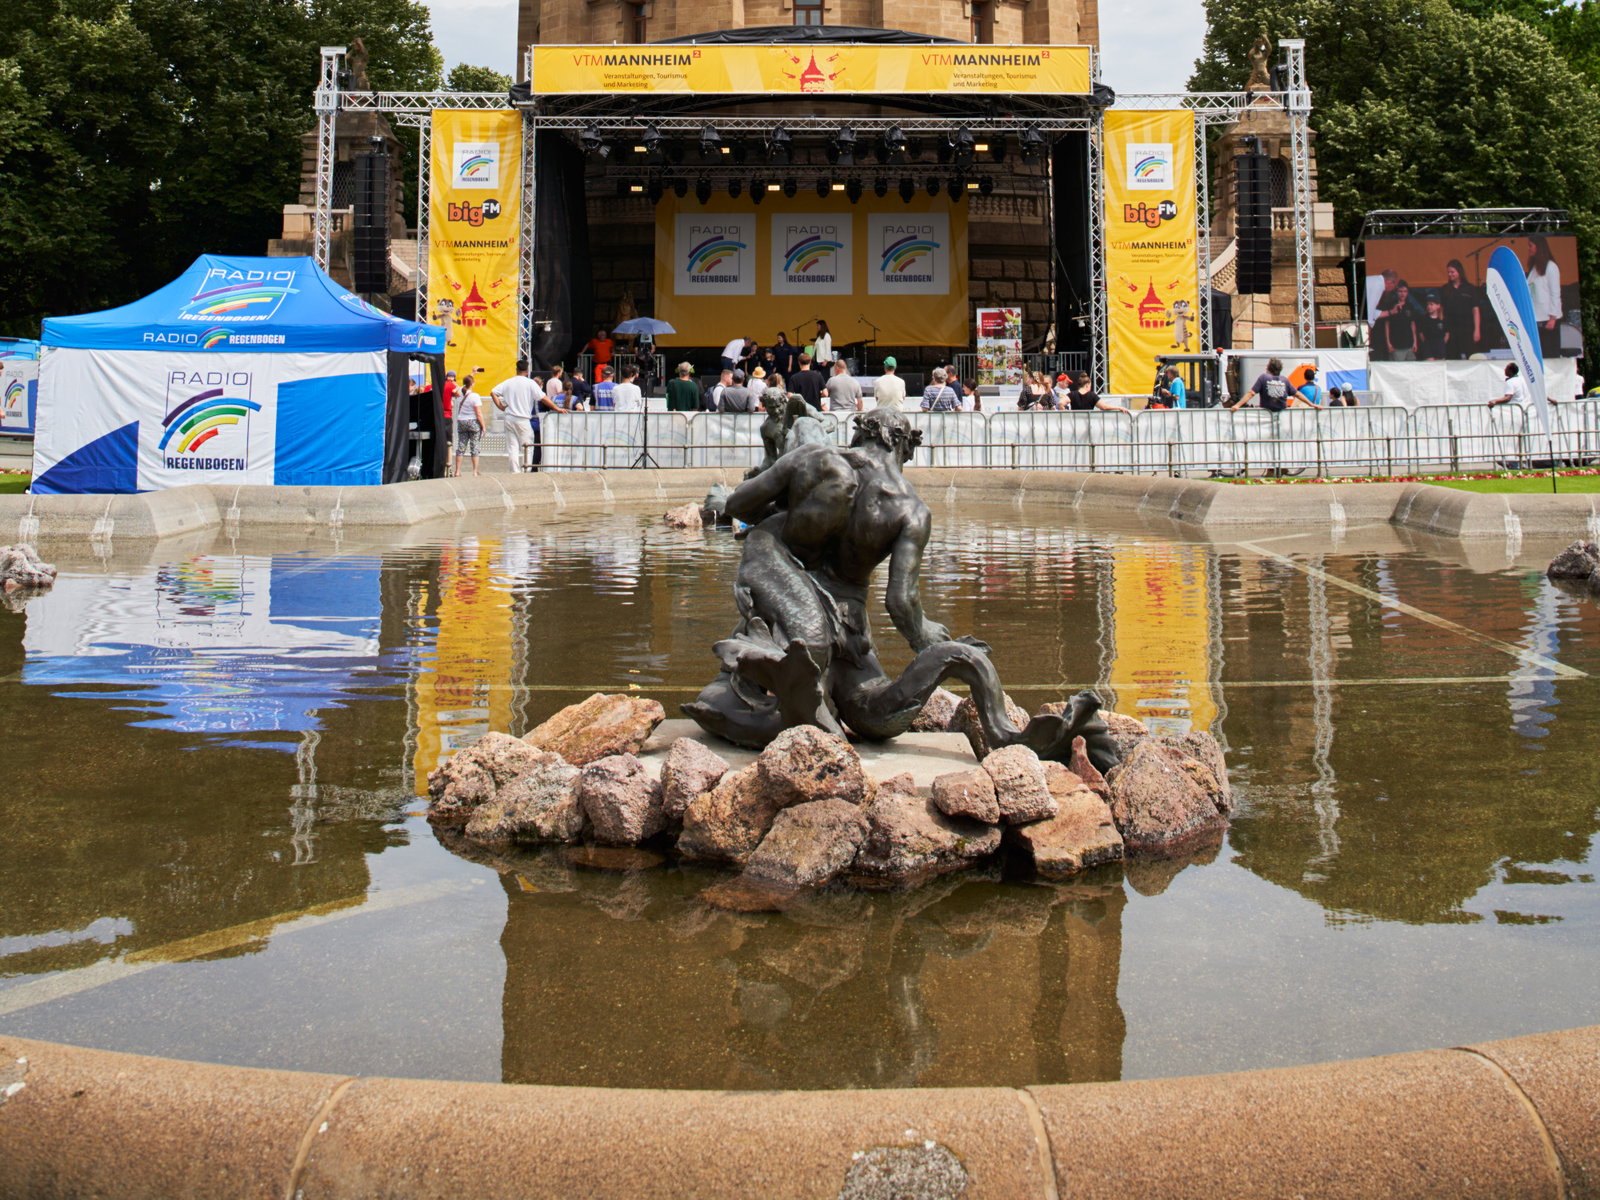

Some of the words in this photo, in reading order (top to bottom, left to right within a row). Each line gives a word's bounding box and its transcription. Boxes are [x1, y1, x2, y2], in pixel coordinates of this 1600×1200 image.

[617, 81, 648, 89] Marketing
[966, 81, 998, 89] Marketing
[691, 225, 739, 235] RADIO
[788, 225, 835, 235] RADIO
[885, 225, 932, 234] RADIO
[209, 268, 292, 281] RADIO
[691, 275, 738, 283] REGENBOGEN
[788, 275, 835, 283] REGENBOGEN
[885, 275, 932, 283] REGENBOGEN
[181, 314, 268, 322] REGENBOGEN
[143, 332, 198, 344] RADIO
[229, 334, 286, 345] REGENBOGEN
[171, 371, 249, 386] RADIO
[166, 457, 245, 471] REGENBOGEN
